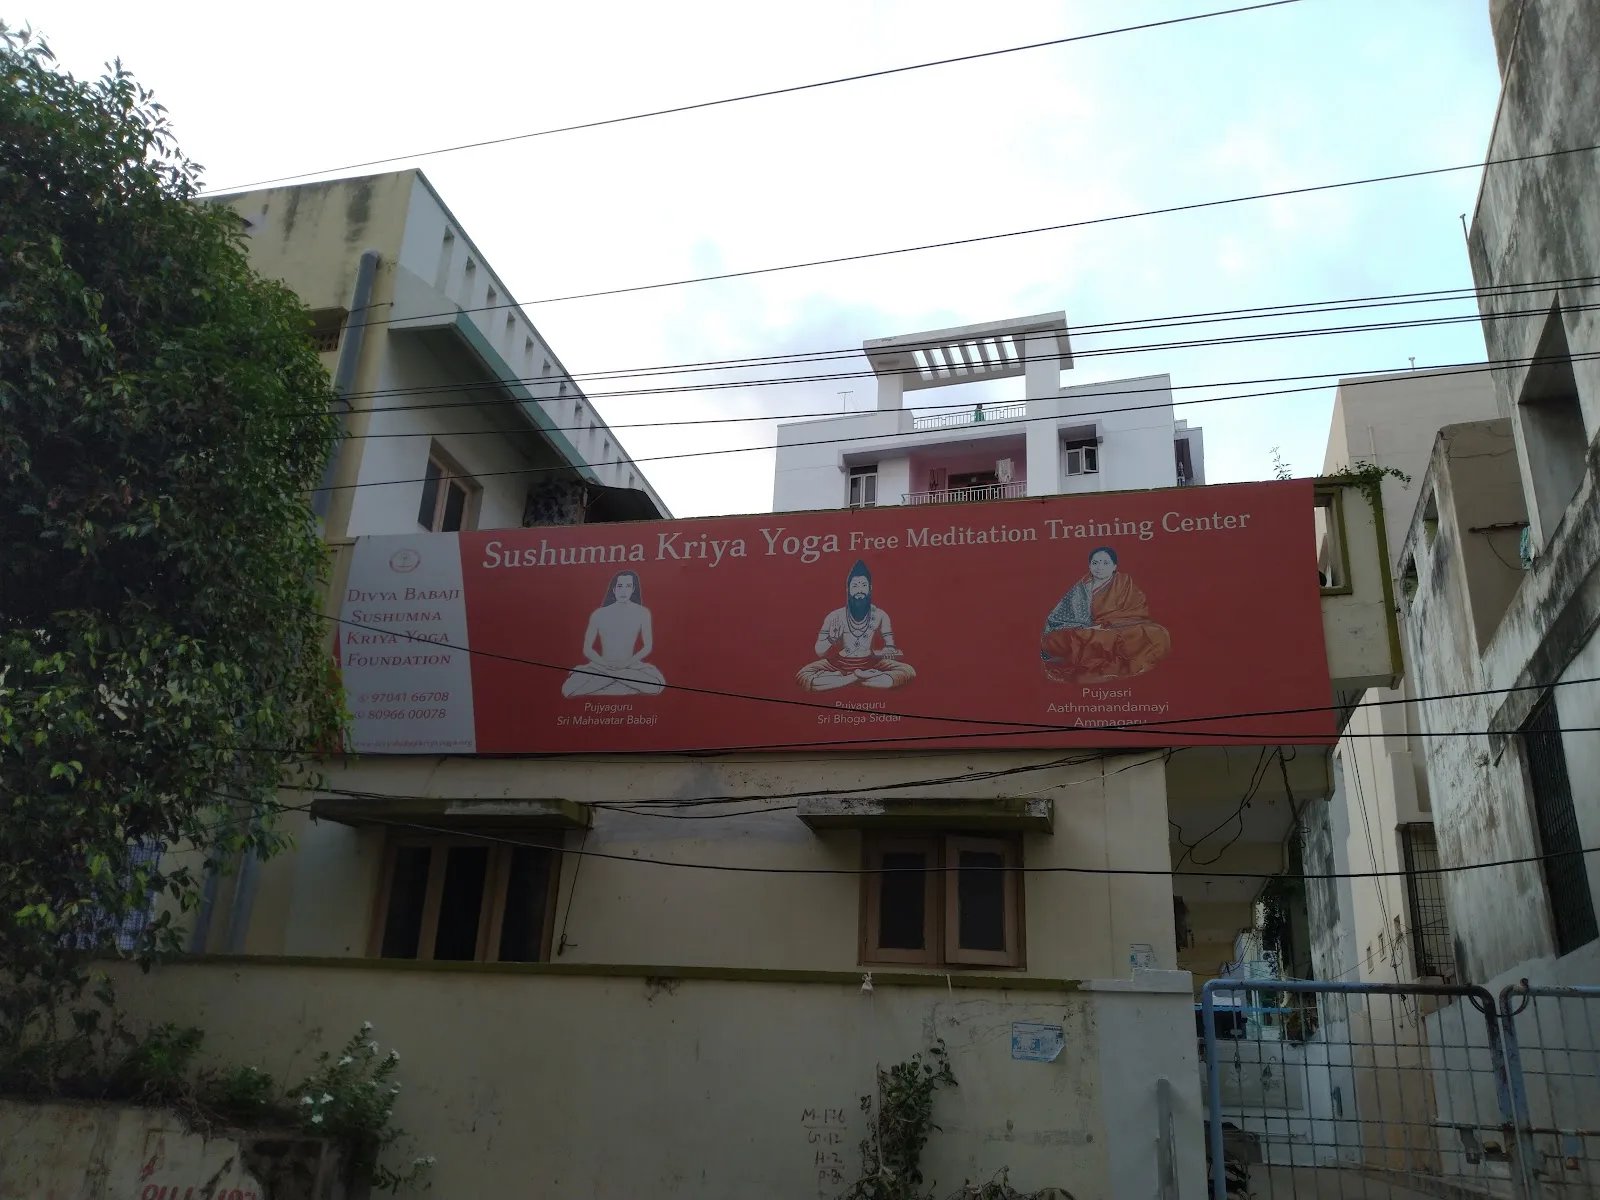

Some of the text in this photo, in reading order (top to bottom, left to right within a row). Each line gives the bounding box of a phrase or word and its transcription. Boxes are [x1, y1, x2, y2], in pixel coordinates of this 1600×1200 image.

[482, 510, 1251, 569] Sushumna Kriya Yoga Free Meditation Training Center
[370, 691, 450, 703] 97041 66708
[1082, 687, 1132, 701] Pujyasri
[367, 708, 447, 721] 80966 00078
[584, 702, 633, 715] Pujyaguru
[1047, 701, 1169, 715] Aathmanandamayi
[556, 714, 658, 727] Sri Mahavatar Babaji
[817, 714, 831, 725] Sri
[833, 713, 866, 726] Bhoga
